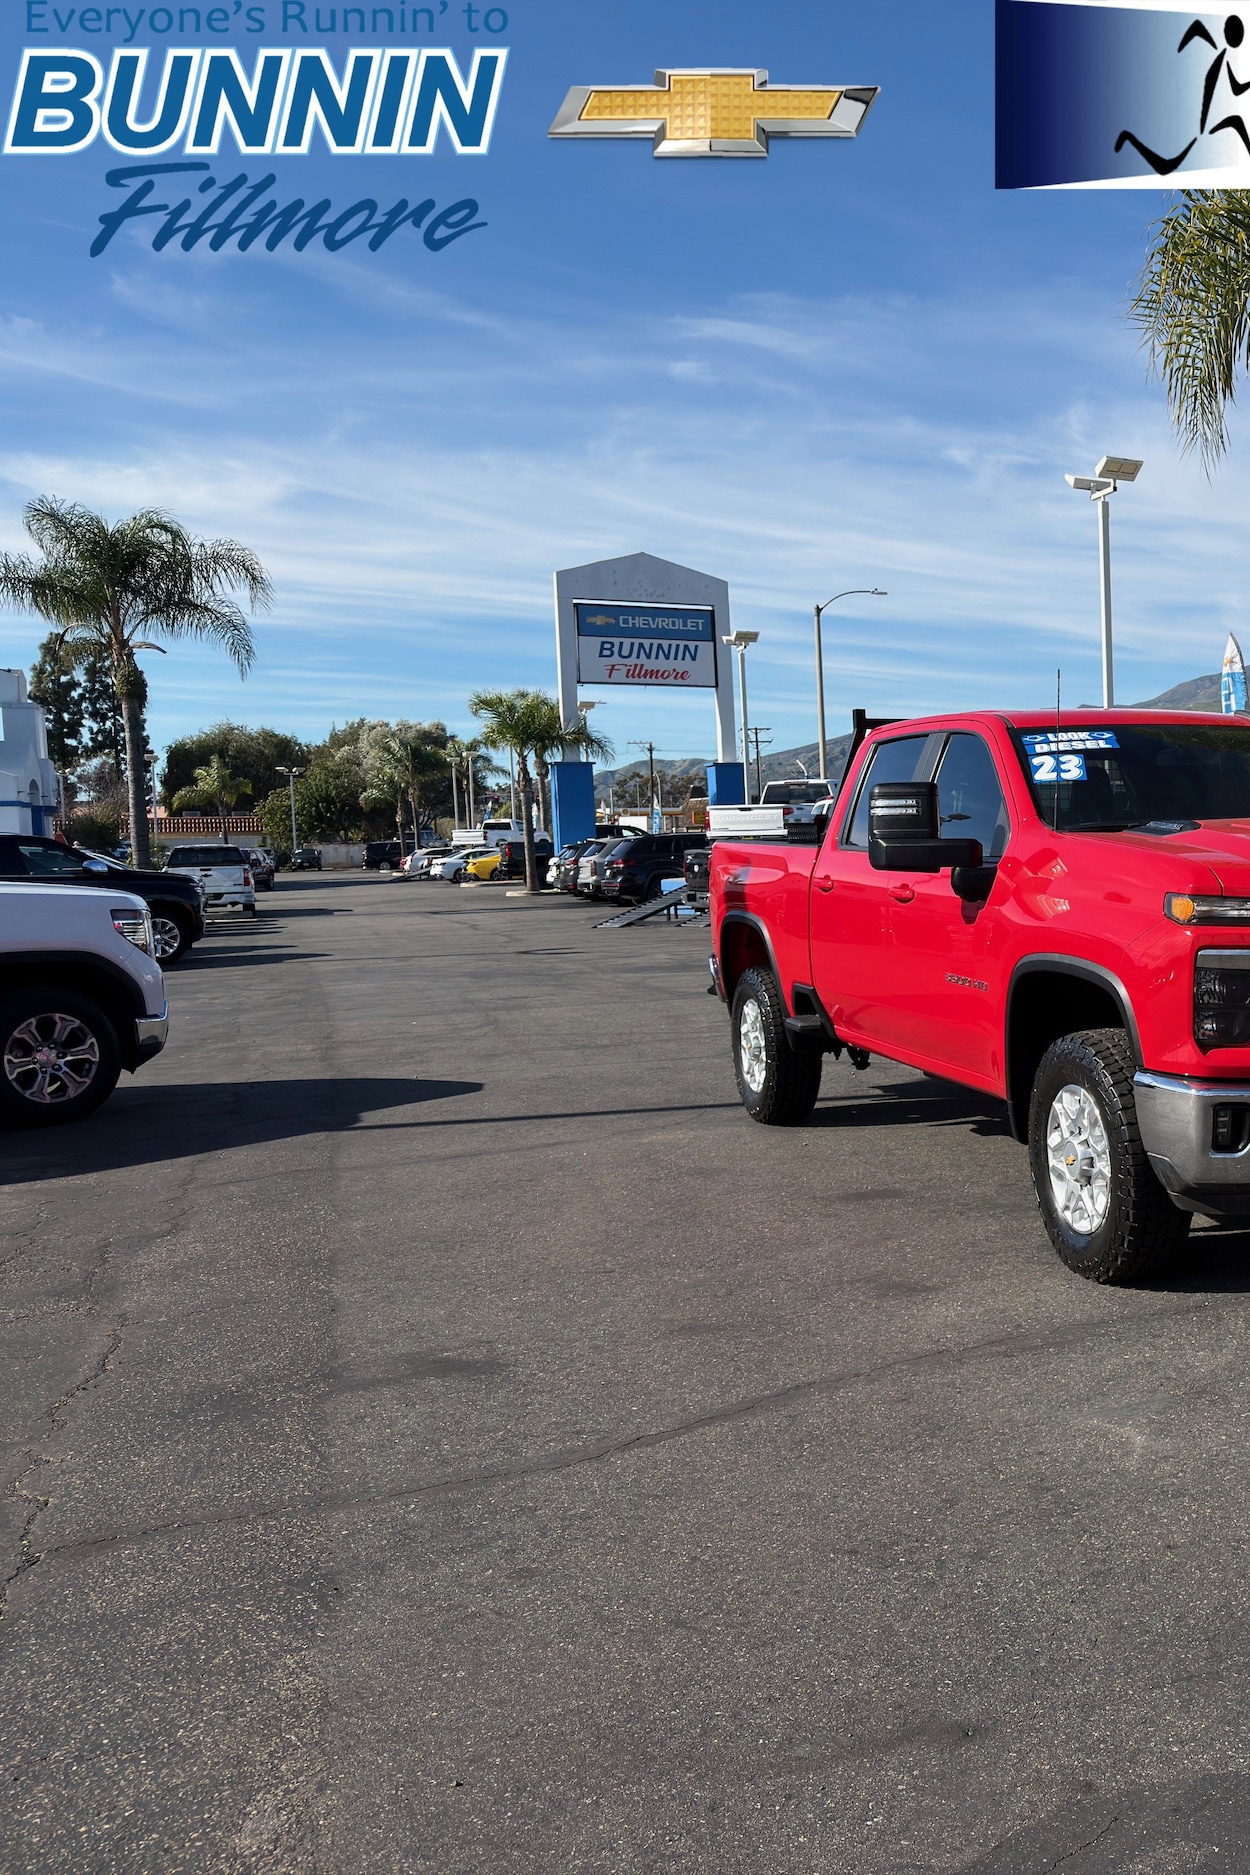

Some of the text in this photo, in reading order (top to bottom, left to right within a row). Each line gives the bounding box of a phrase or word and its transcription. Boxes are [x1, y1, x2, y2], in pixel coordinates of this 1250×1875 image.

[619, 616, 705, 630] CHEVROLET
[598, 640, 699, 662] BUNNIN
[604, 663, 692, 681] Fillmore
[1047, 732, 1093, 741] LOOK
[1035, 740, 1112, 753] DIESEL
[1031, 754, 1084, 781] 23
